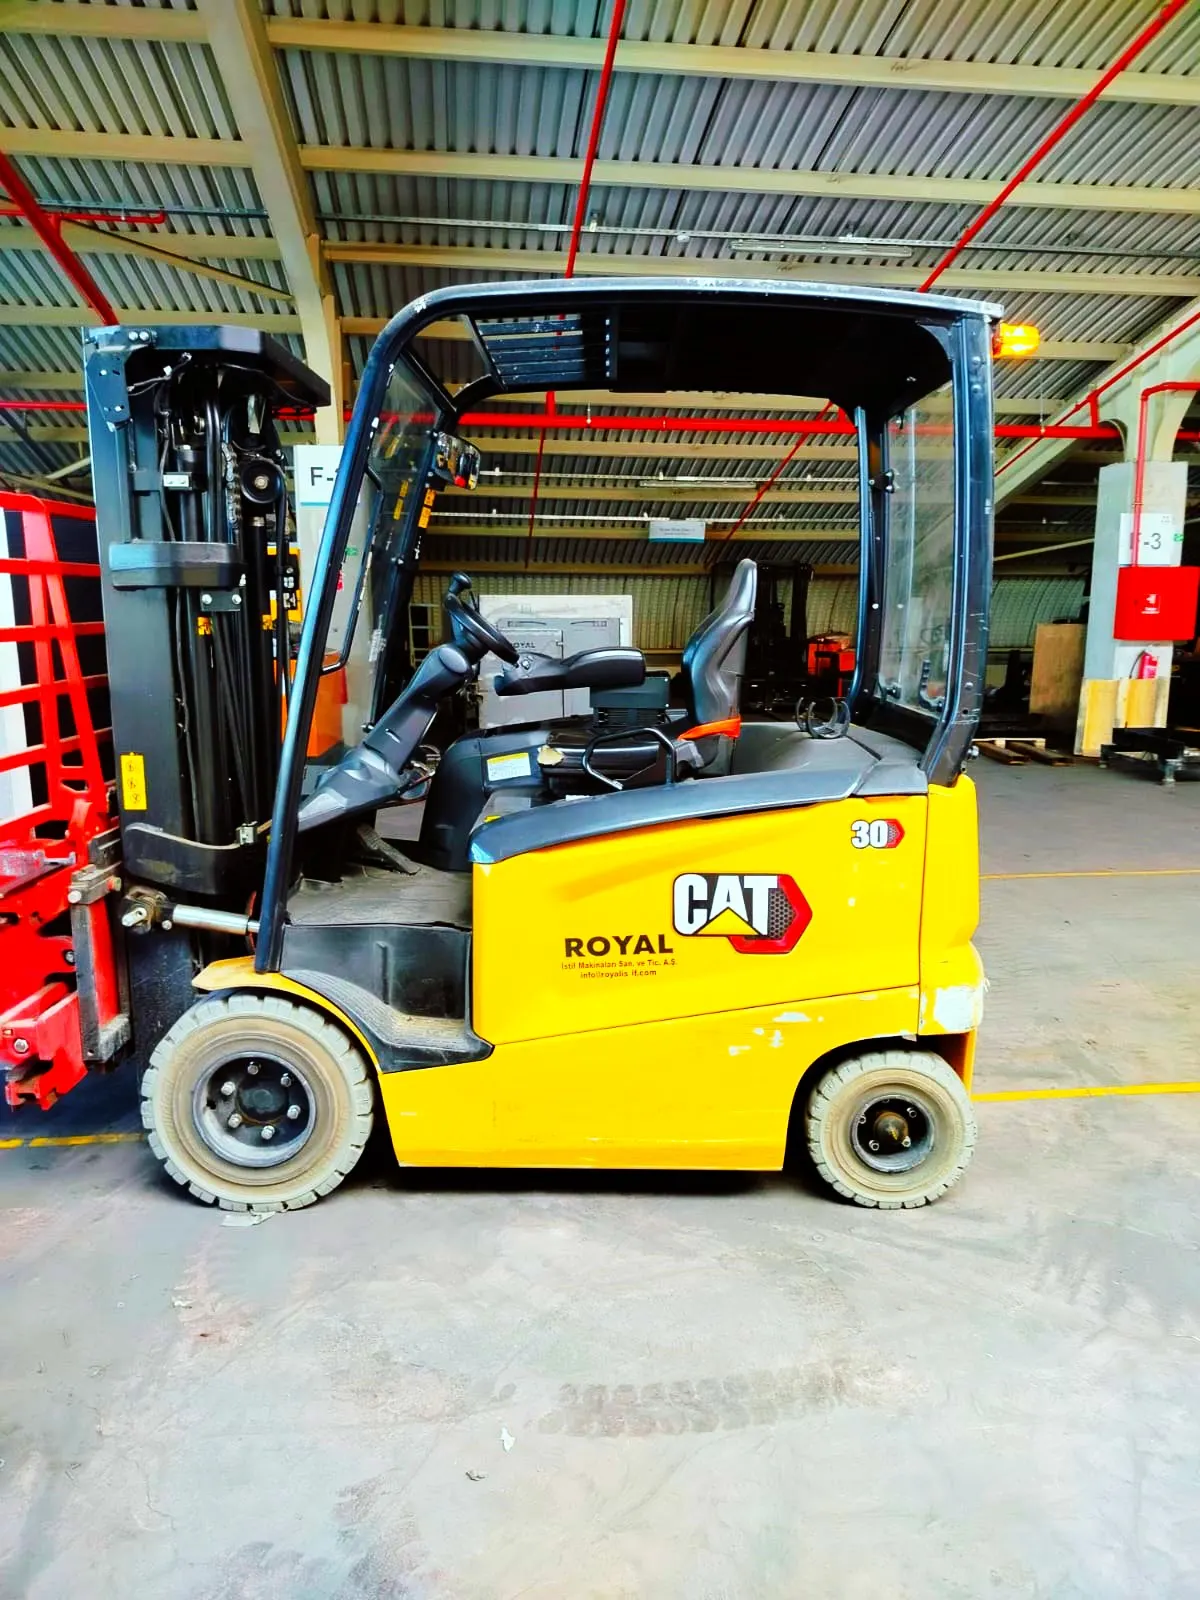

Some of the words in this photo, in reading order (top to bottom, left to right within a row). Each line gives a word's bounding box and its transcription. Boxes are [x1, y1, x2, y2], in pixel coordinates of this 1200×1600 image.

[310, 466, 339, 486] F-
[512, 641, 536, 649] OYAL
[851, 819, 889, 849] 30
[673, 873, 778, 936] CAT
[564, 933, 674, 957] ROYAL
